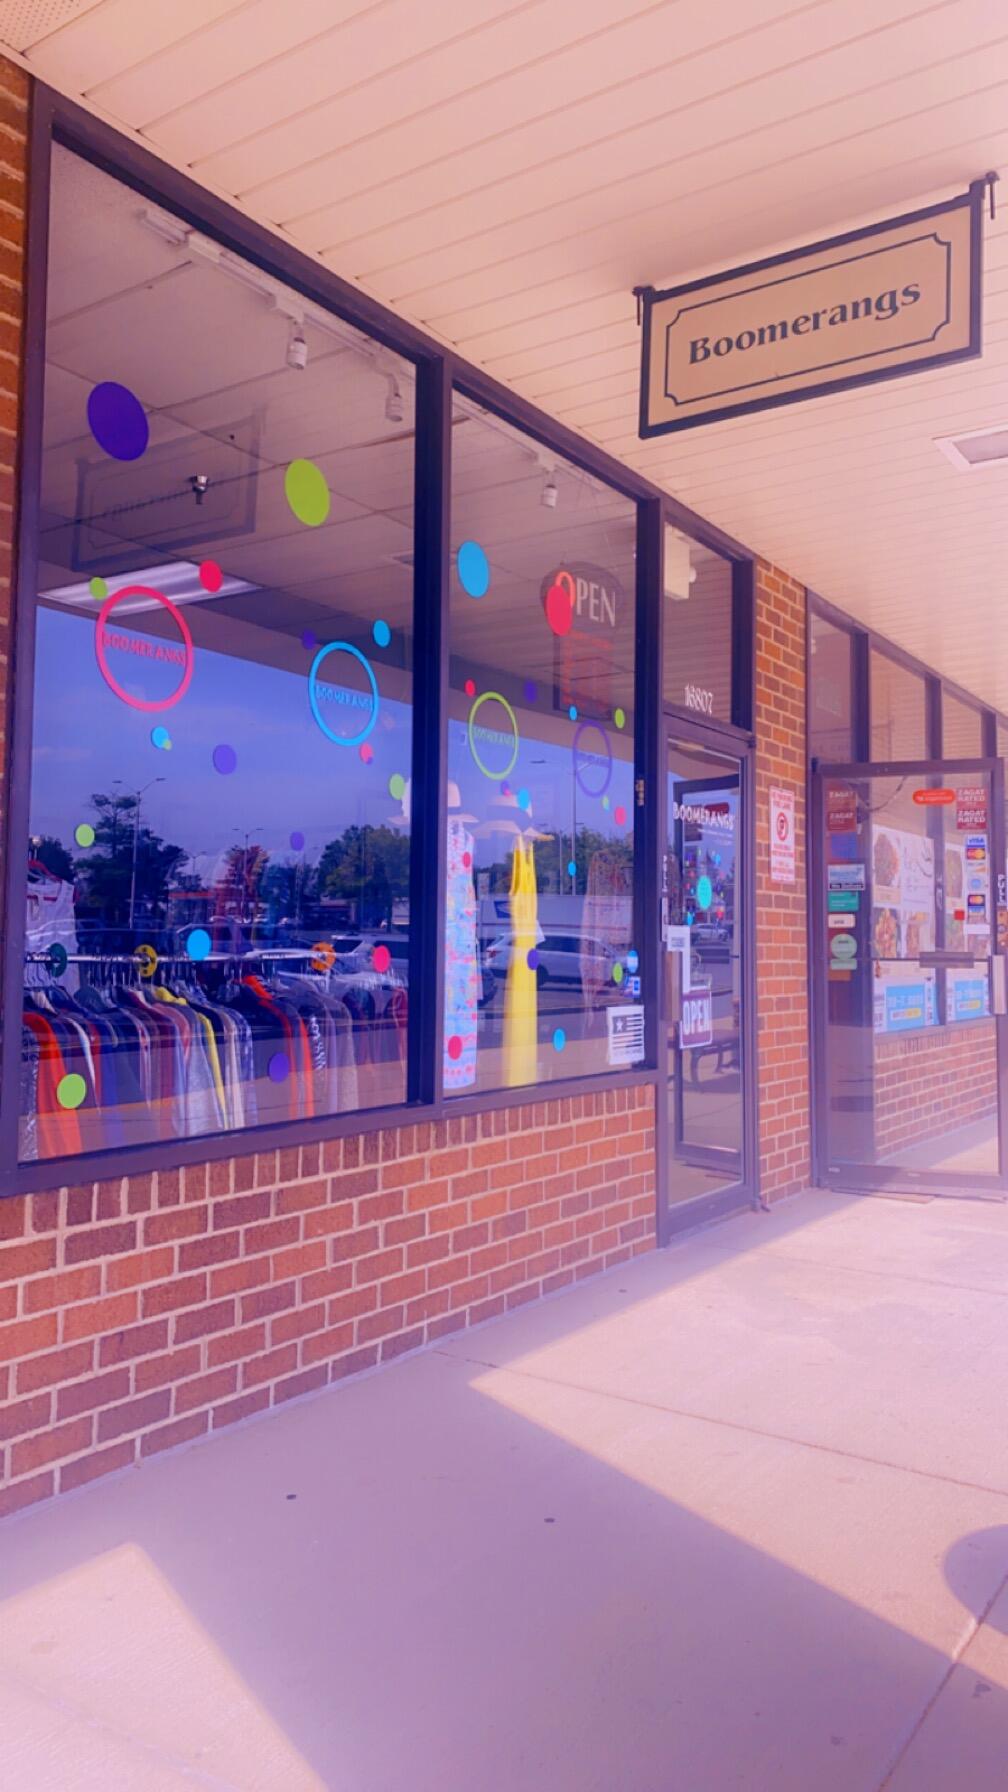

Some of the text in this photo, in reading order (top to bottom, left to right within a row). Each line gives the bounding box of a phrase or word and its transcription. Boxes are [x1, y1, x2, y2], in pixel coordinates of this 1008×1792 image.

[689, 283, 921, 364] Boomerangs
[555, 571, 616, 627] OPEN
[673, 801, 735, 831] BOOMERANGS
[683, 999, 710, 1036] OPEN
